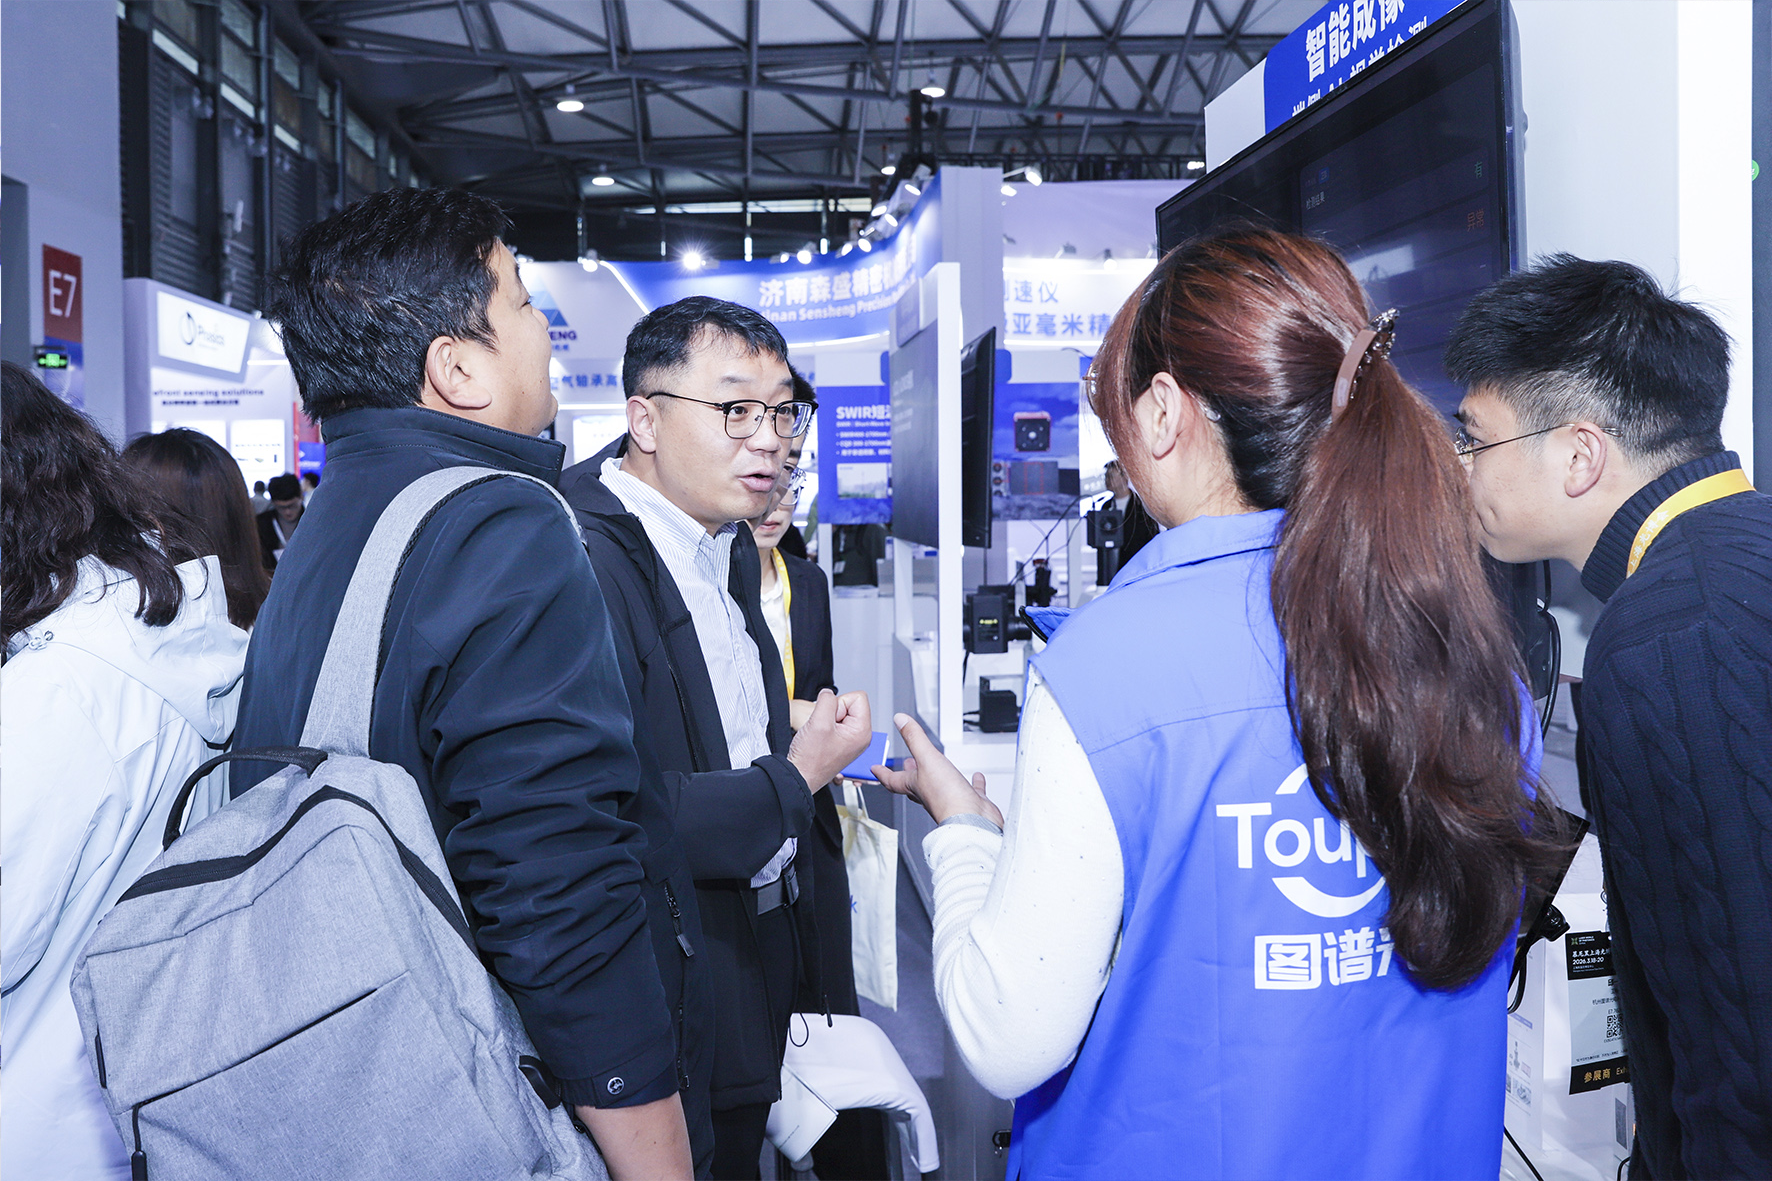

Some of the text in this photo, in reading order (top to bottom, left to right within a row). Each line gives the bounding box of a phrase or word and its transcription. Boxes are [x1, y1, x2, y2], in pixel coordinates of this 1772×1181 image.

[1305, 0, 1406, 83] 智能成像
[49, 269, 77, 318] E7
[798, 303, 856, 321] Sensheng
[1003, 312, 1112, 337] 亚毫米精
[1583, 1068, 1612, 1084] 参展商
